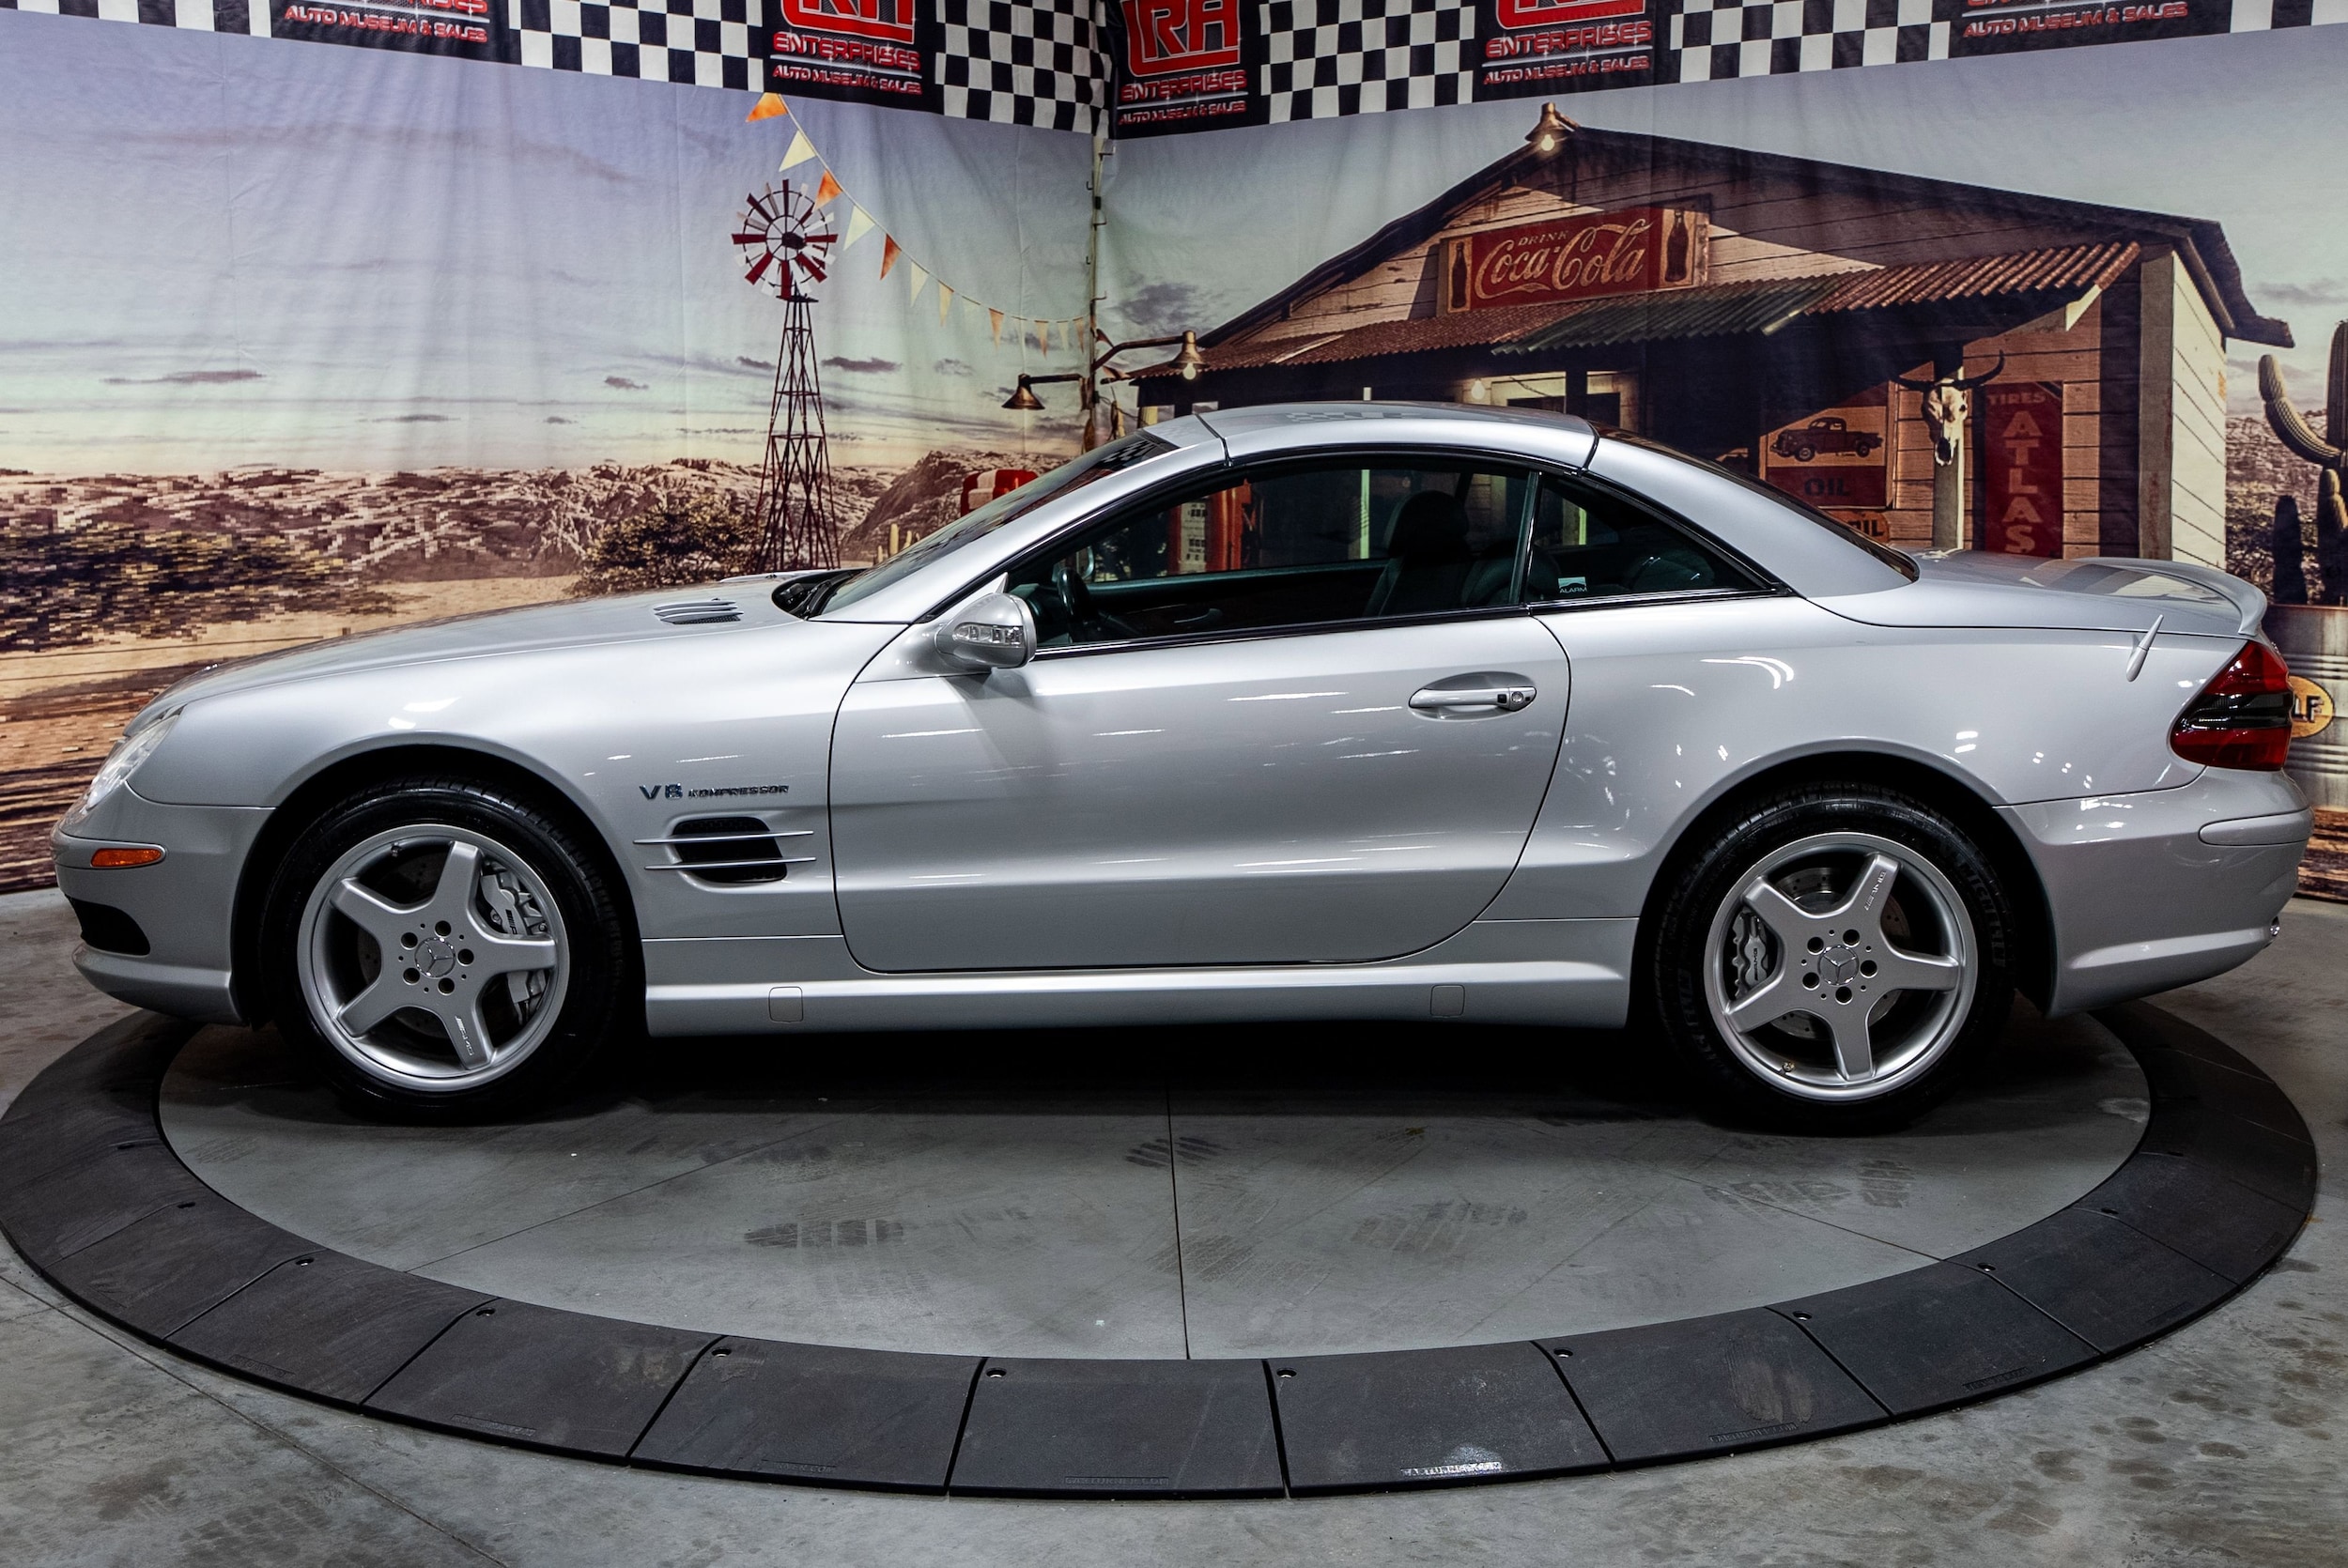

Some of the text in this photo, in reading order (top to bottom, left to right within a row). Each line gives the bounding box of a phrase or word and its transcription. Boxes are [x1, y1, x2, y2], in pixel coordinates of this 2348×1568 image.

[285, 6, 488, 43] AUTO MUSEUM & SALES
[1963, 1, 2188, 38] AUTO MUSEUM & SALES
[773, 31, 921, 70] ENTERPRISES
[1485, 21, 1653, 58] ENTERPRISES
[773, 65, 811, 82] AUTO
[812, 69, 870, 89] MUSEUM
[879, 78, 923, 95] SALES
[1483, 55, 1650, 85] AUTO MUSEUM & SALES
[1120, 69, 1247, 103] ENTERPRISES
[1119, 110, 1151, 125] AUTO
[1151, 106, 1198, 122] MUSEUM
[1209, 100, 1247, 115] SALES
[1517, 229, 1570, 248] DRINK
[1987, 392, 2047, 406] TIRES
[1804, 477, 1851, 497] OIL
[2001, 410, 2044, 554] ATLAS
[2293, 696, 2325, 723] LF
[687, 785, 790, 798] KOMPRESSOR
